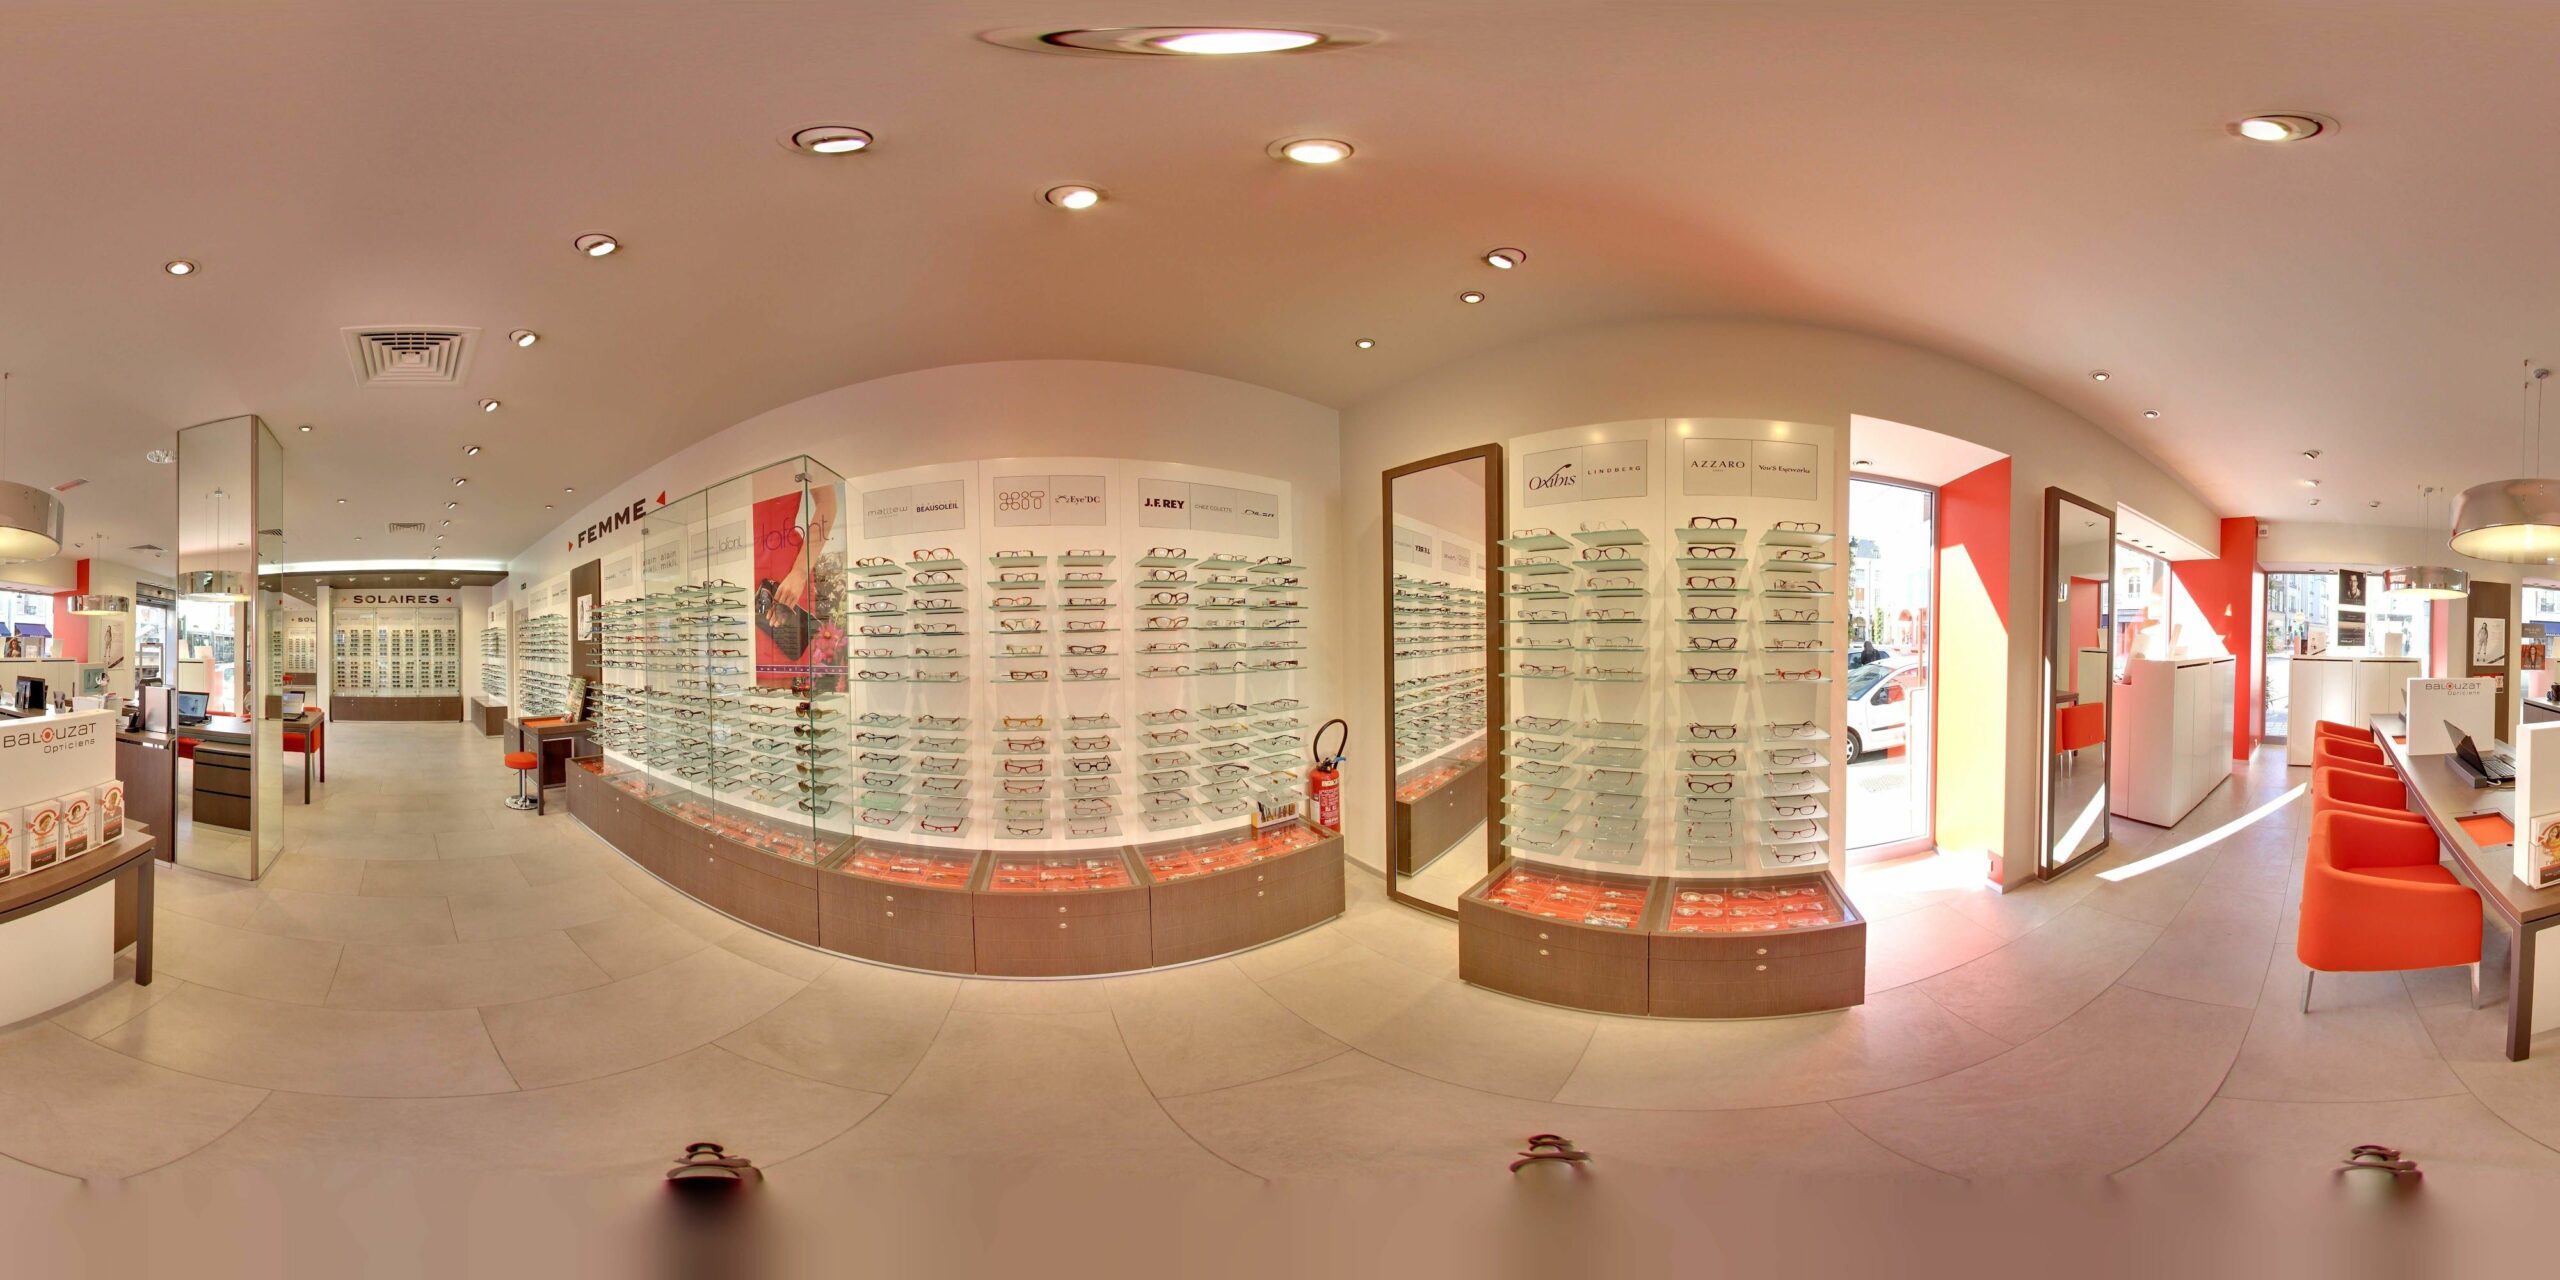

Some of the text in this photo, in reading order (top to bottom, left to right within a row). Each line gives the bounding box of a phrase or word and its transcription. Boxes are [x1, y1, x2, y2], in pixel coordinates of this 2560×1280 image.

[1690, 460, 1745, 468] AZZARO
[1587, 466, 1641, 475] LINDBERG
[1528, 463, 1577, 491] Oxibis
[916, 503, 959, 513] BEAUSOLEIL
[1209, 505, 1233, 513] COLETTE
[578, 498, 647, 548] FEMME
[353, 595, 440, 604] SOLAIRES
[44, 738, 96, 754] Opticiens
